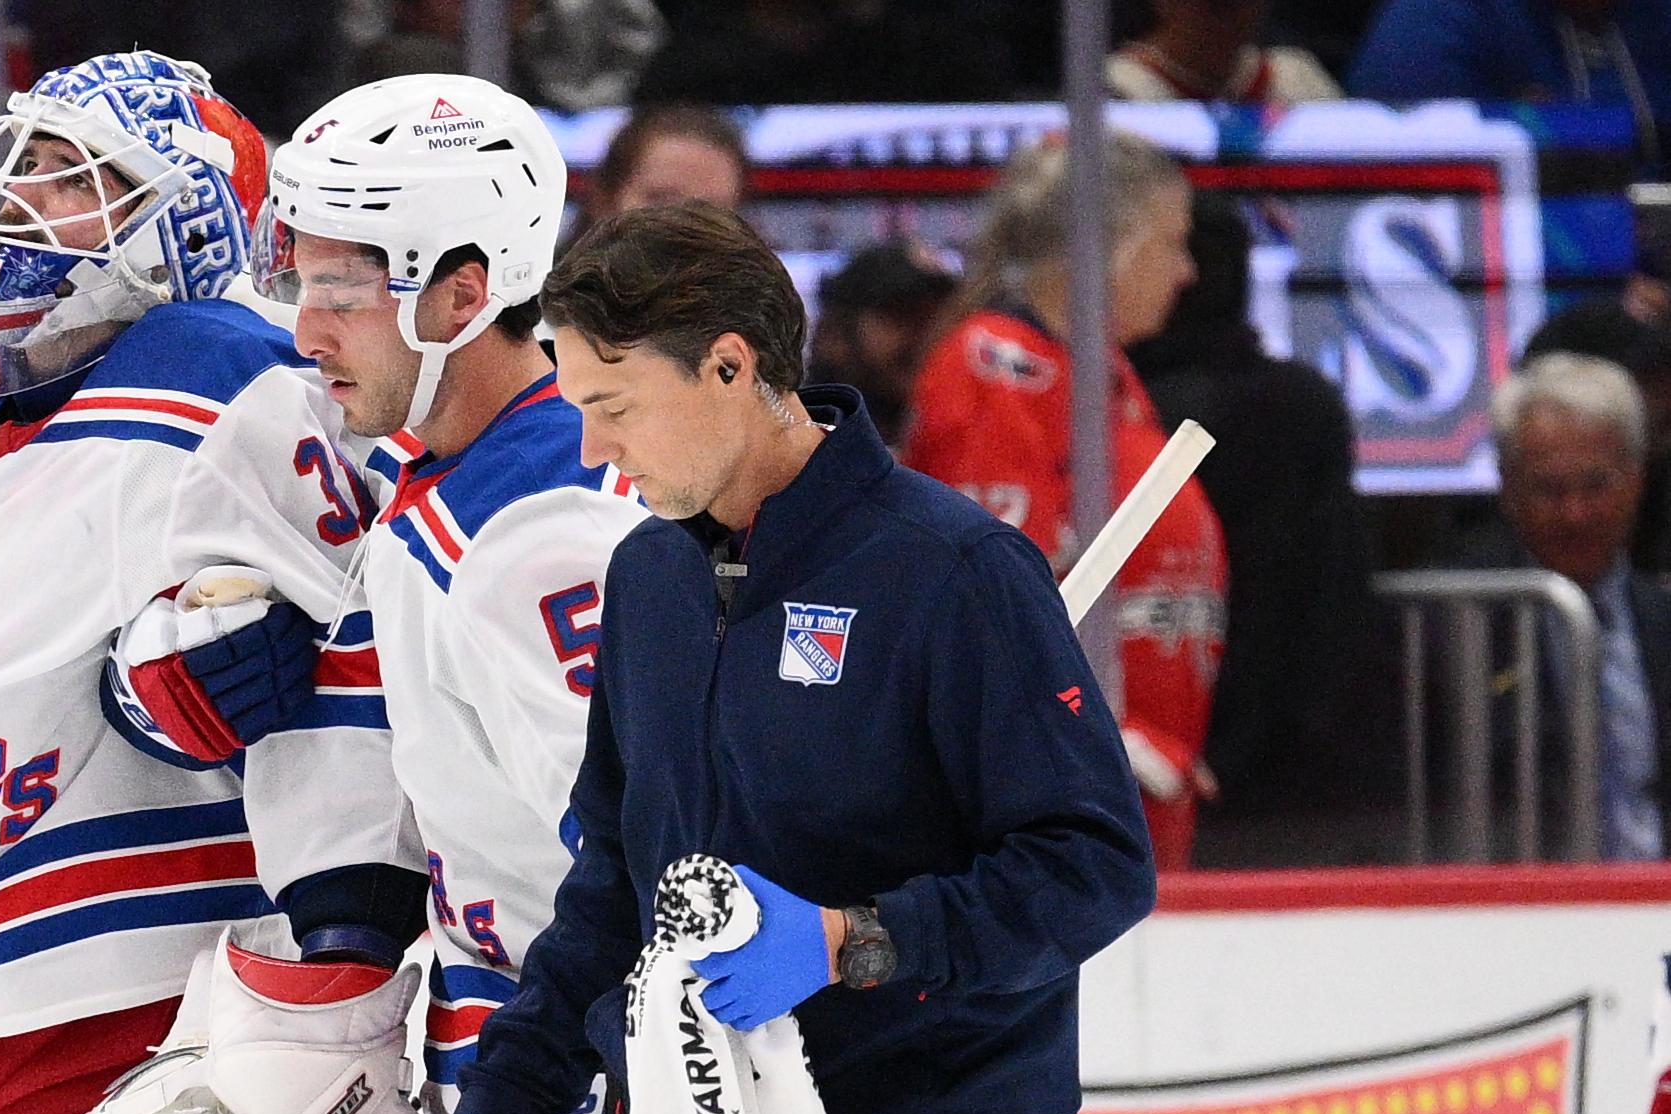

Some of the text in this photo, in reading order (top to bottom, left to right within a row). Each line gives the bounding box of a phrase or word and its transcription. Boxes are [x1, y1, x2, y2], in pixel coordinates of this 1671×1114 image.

[304, 119, 339, 144] 5
[413, 118, 485, 137] Benjamin
[428, 136, 477, 150] Moore
[272, 169, 300, 190] BAUER
[292, 435, 380, 547] 31
[790, 612, 844, 631] NEW YORK
[538, 581, 602, 697] 5
[795, 632, 836, 677] RANGERS
